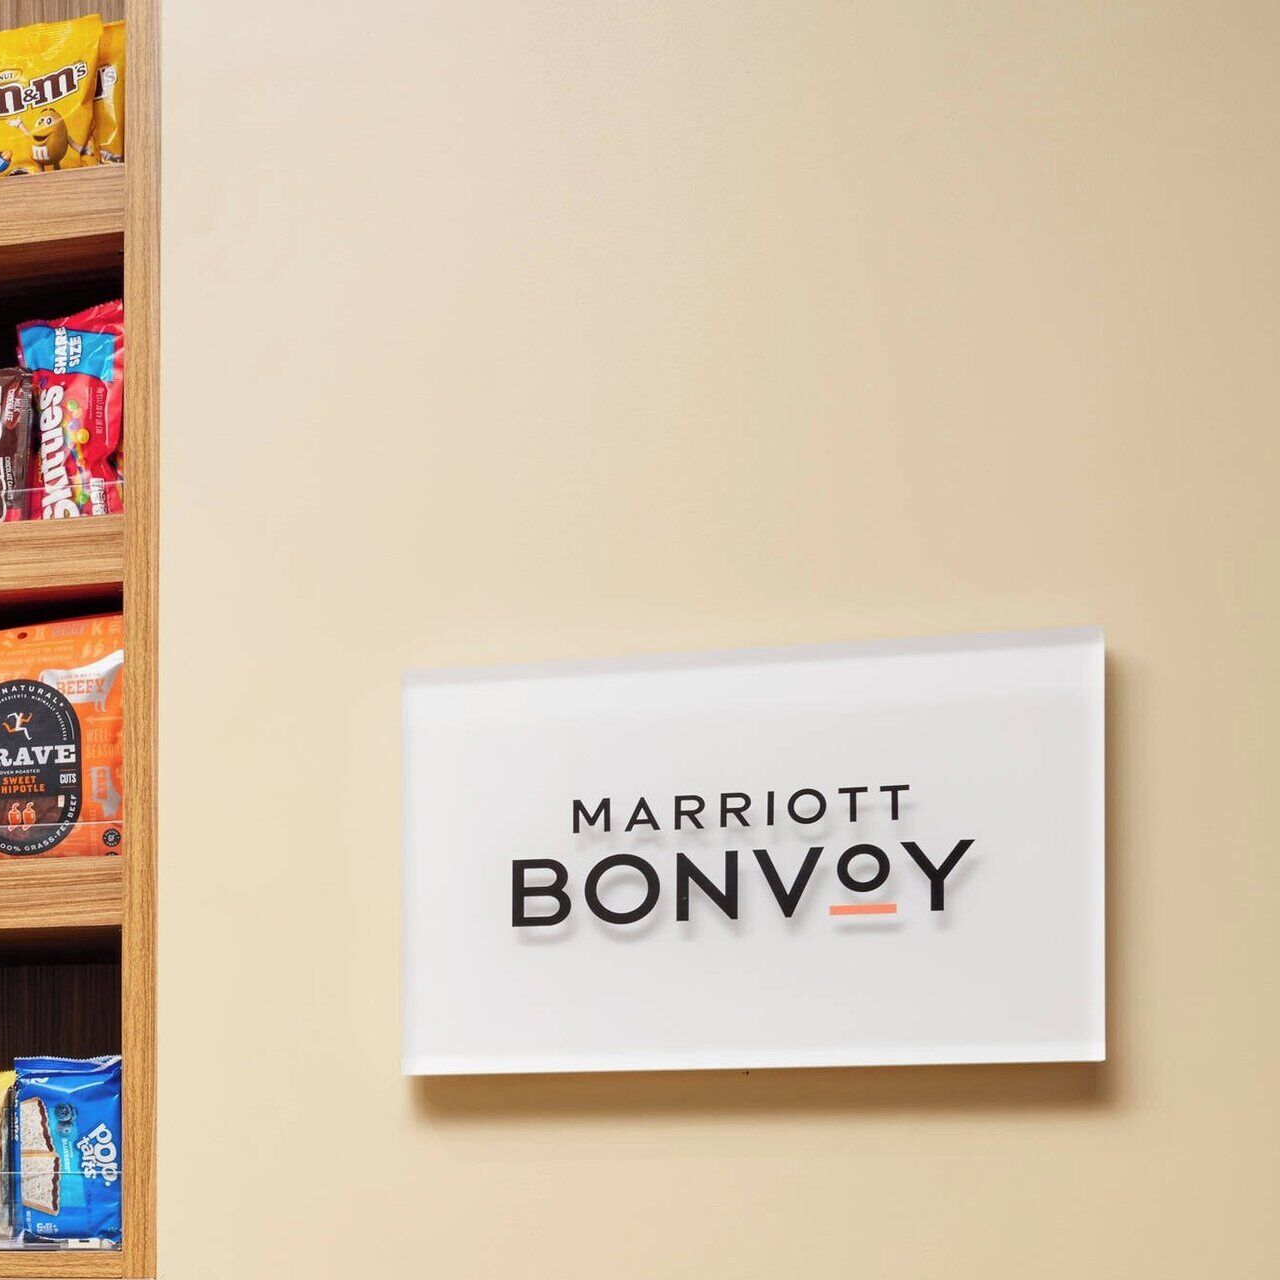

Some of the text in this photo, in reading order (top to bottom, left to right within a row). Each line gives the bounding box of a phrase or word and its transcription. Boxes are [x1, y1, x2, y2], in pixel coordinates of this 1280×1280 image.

[54, 326, 66, 373] SHARE
[68, 335, 82, 367] SIZE
[3, 776, 37, 785] SWEET
[60, 774, 76, 784] CUTS
[572, 784, 910, 834] MARRIOTT
[511, 838, 975, 927] BONVOY
